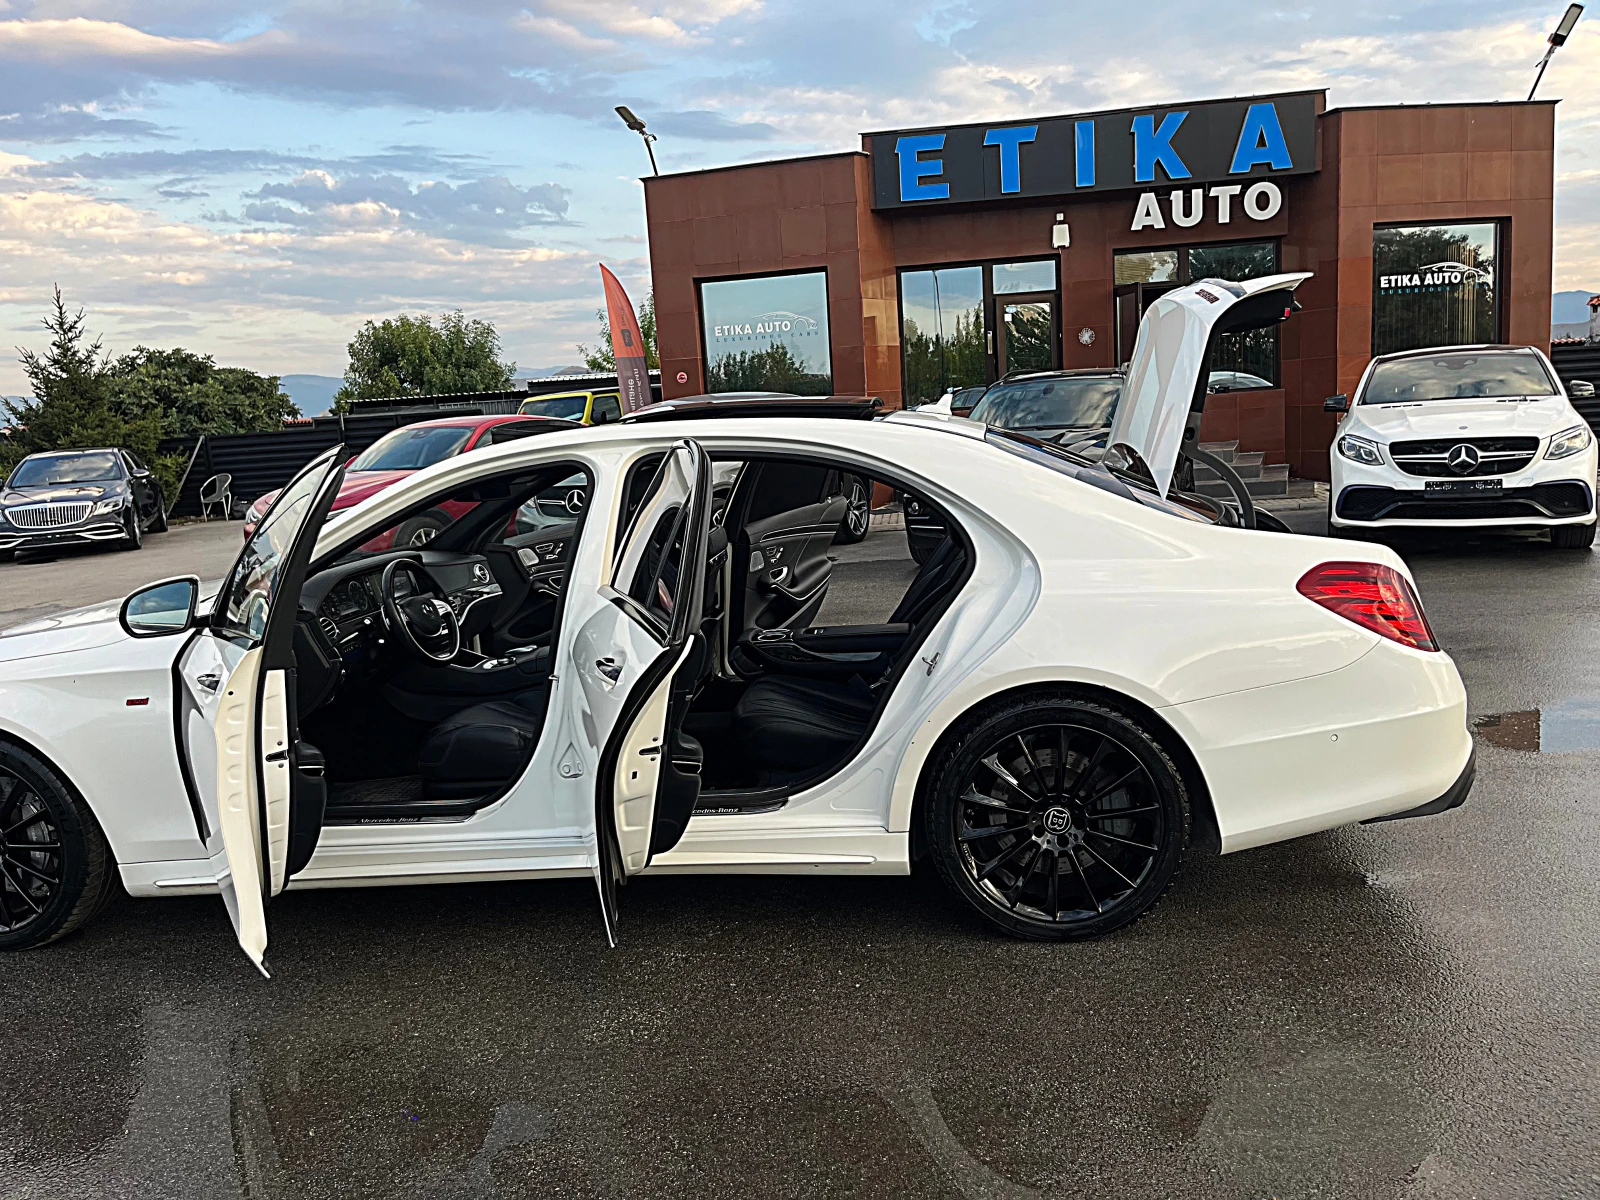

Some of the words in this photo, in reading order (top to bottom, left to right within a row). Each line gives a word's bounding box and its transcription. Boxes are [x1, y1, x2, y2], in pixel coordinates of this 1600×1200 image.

[895, 102, 1293, 202] ETIKA
[1131, 181, 1282, 231] AUTO
[1380, 274, 1420, 288] ETIKA
[1424, 272, 1461, 285] AUTO
[714, 323, 752, 337] ETIKA
[756, 320, 791, 334] AUTO
